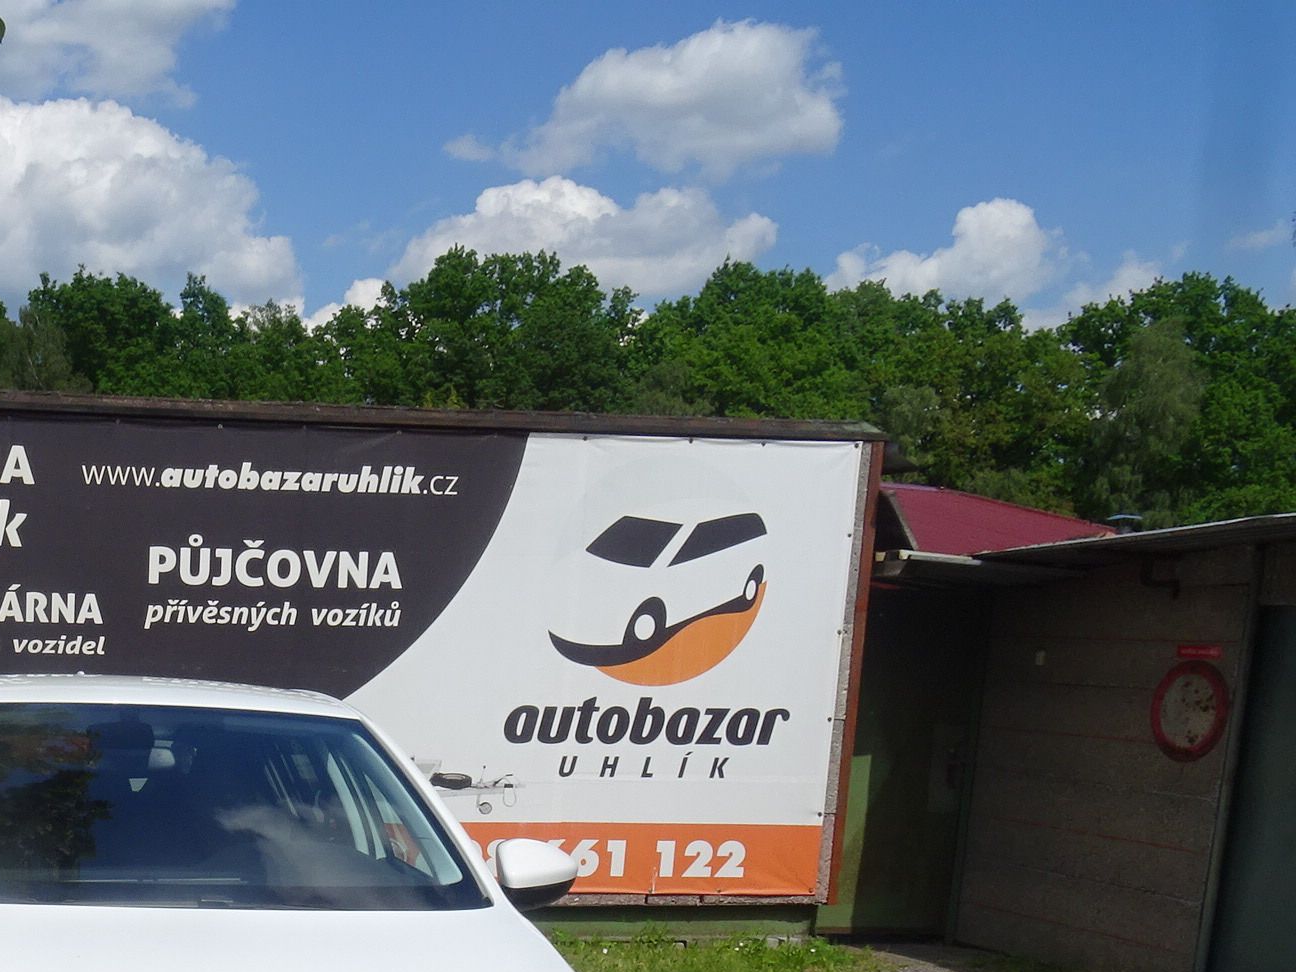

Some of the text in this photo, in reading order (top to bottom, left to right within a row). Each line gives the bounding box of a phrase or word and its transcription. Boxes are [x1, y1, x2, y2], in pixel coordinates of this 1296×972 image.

[81, 462, 459, 495] www.autobazaruhlik.cz
[147, 534, 403, 590] PŮJČOVNA
[144, 599, 403, 631] přívěsných vozíků
[12, 635, 106, 657] vozidel
[503, 696, 791, 745] autobazar
[558, 752, 731, 779] UHLÍK
[655, 839, 747, 878] 122
